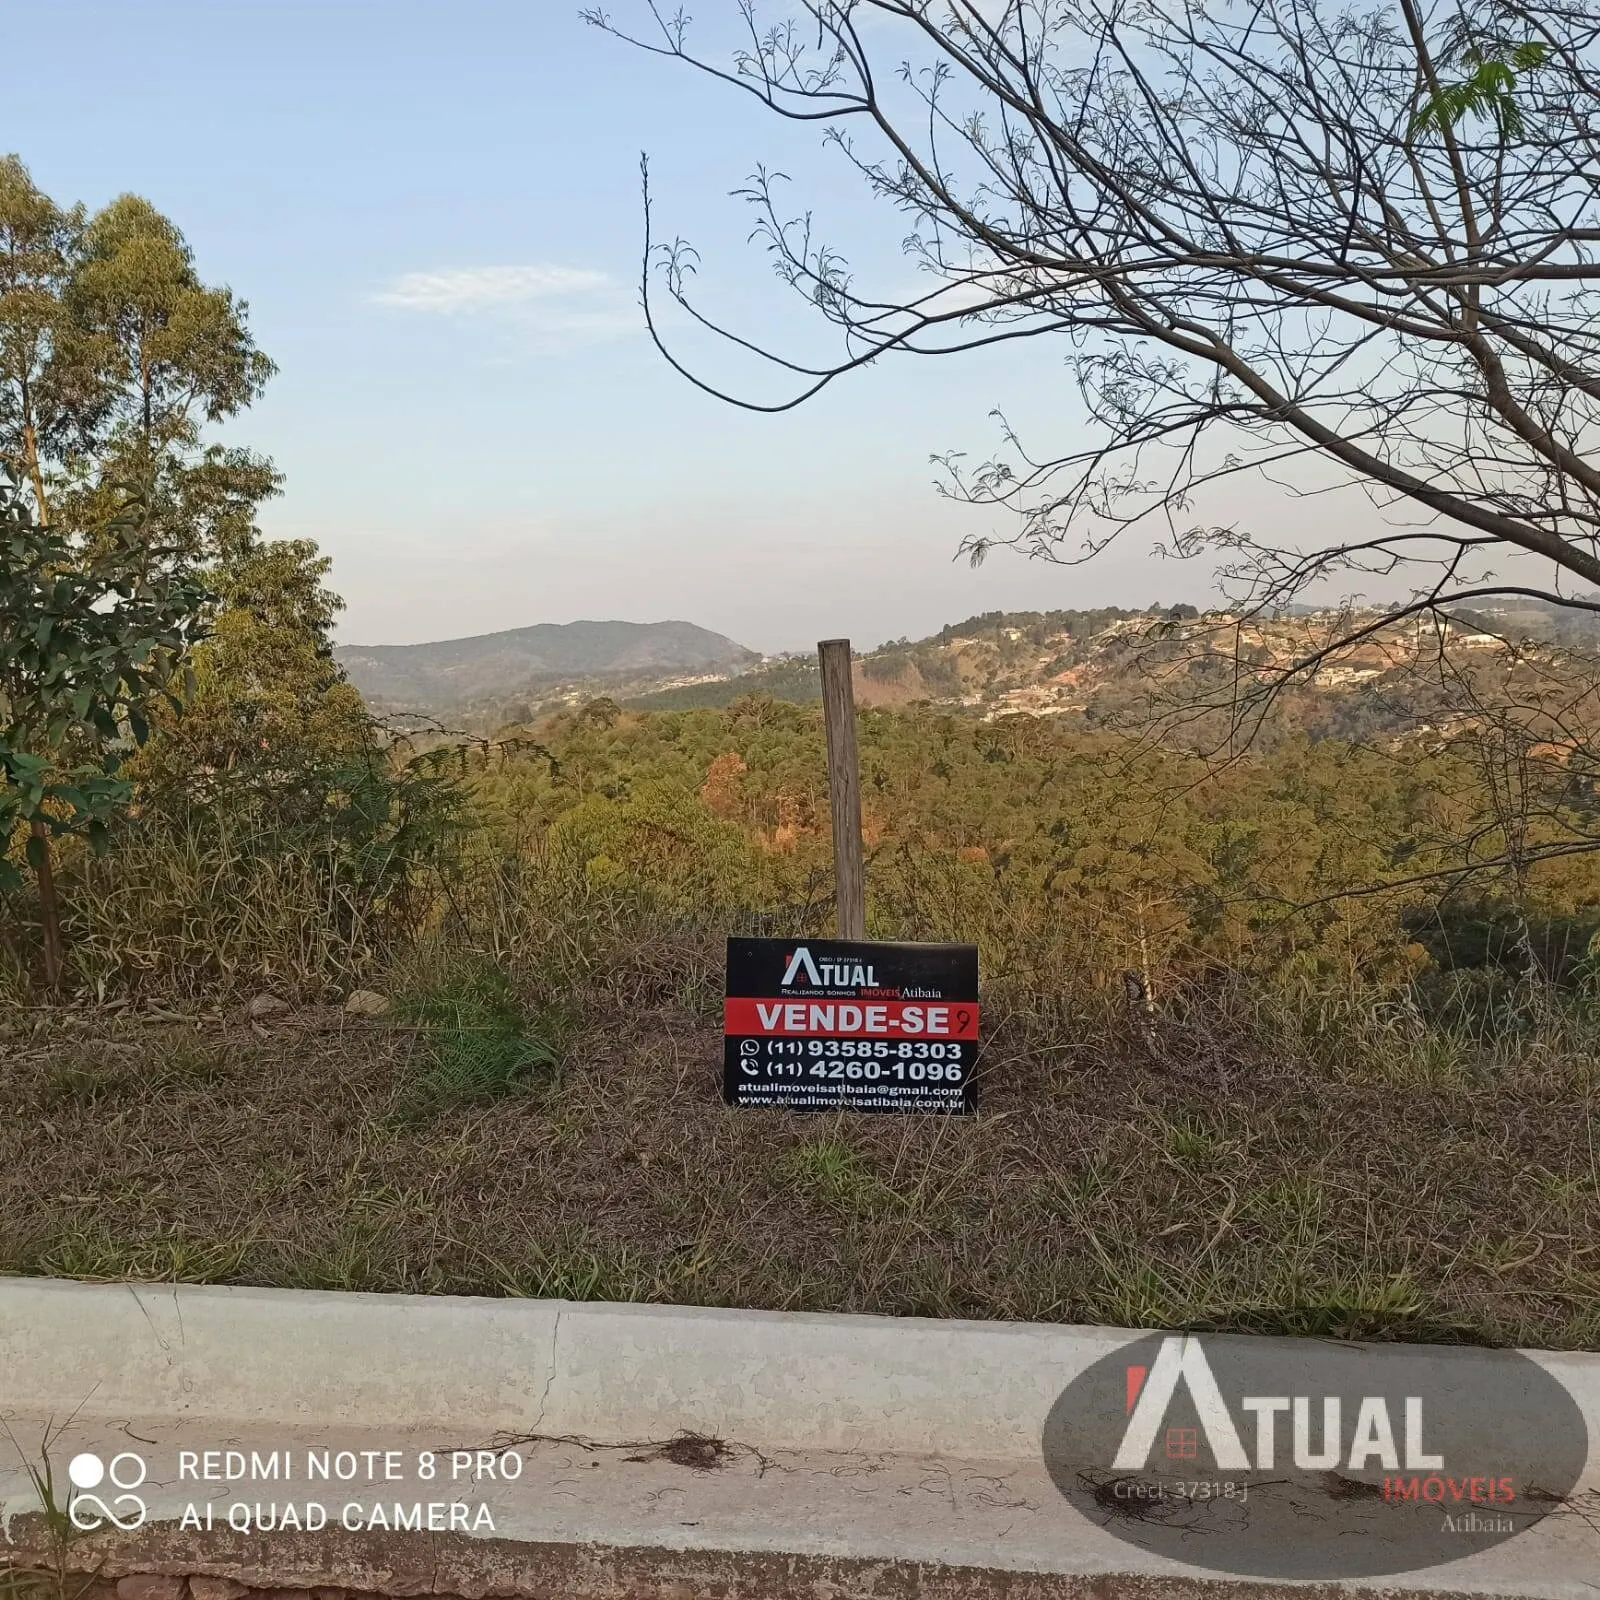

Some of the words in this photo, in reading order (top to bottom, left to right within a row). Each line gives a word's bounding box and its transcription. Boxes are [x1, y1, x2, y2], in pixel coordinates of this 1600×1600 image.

[781, 947, 879, 986] ATUAL
[902, 987, 942, 999] Atibaia
[756, 1004, 949, 1034] VENDE-SE
[956, 1010, 971, 1034] 9
[767, 1040, 803, 1055] (11)
[808, 1040, 962, 1060] 93585-8303
[766, 1062, 803, 1077] (11)
[809, 1060, 962, 1081] 4260-1096
[738, 1082, 963, 1097] atualimoveisatibaia@gmail.com
